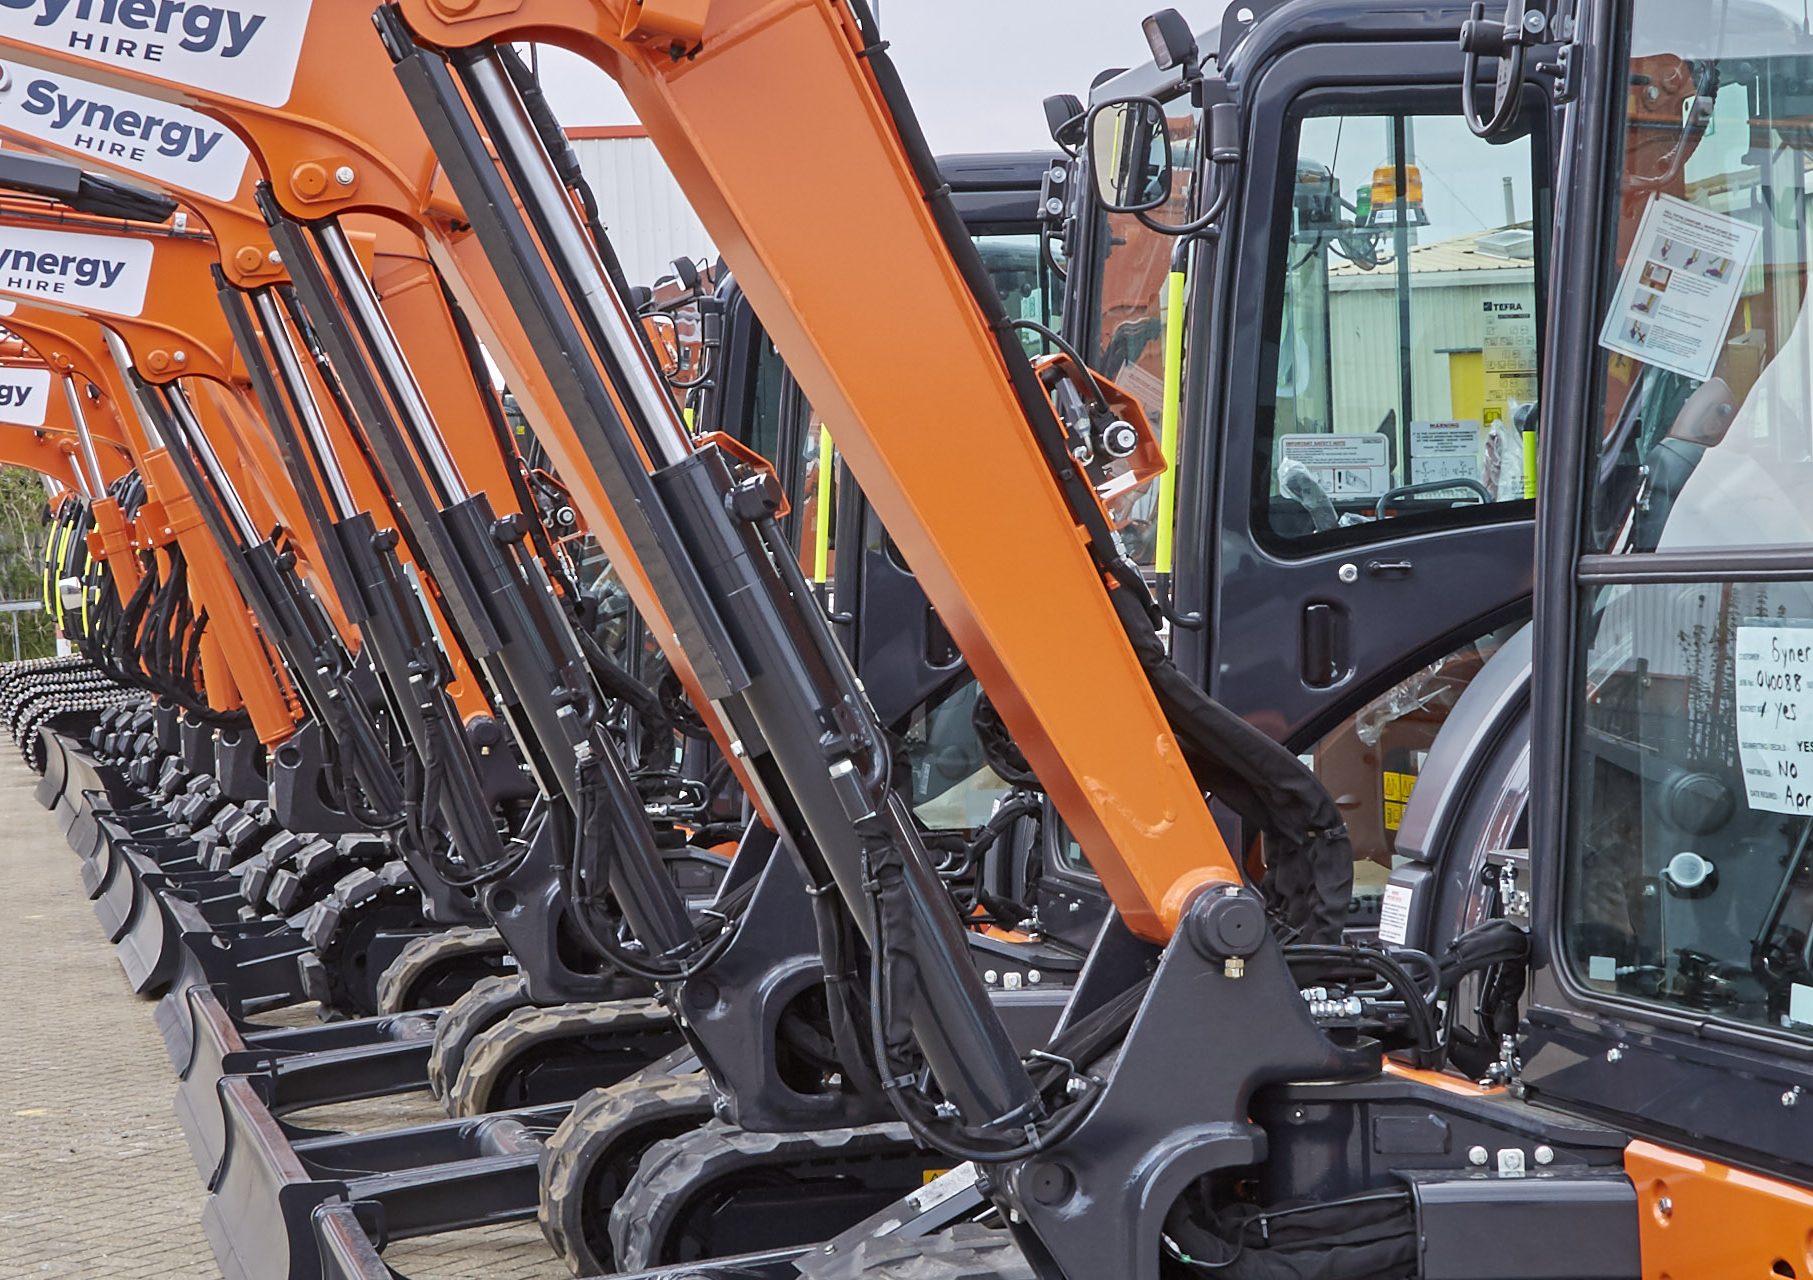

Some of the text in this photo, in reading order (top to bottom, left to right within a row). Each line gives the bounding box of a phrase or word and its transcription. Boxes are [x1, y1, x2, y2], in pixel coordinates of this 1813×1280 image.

[68, 30, 164, 62] HIRE
[21, 79, 223, 162] Synergy
[74, 134, 145, 162] HIRE
[7, 277, 64, 294] HIRE
[1493, 303, 1522, 311] TEFRA
[1757, 670, 1801, 692] 040088
